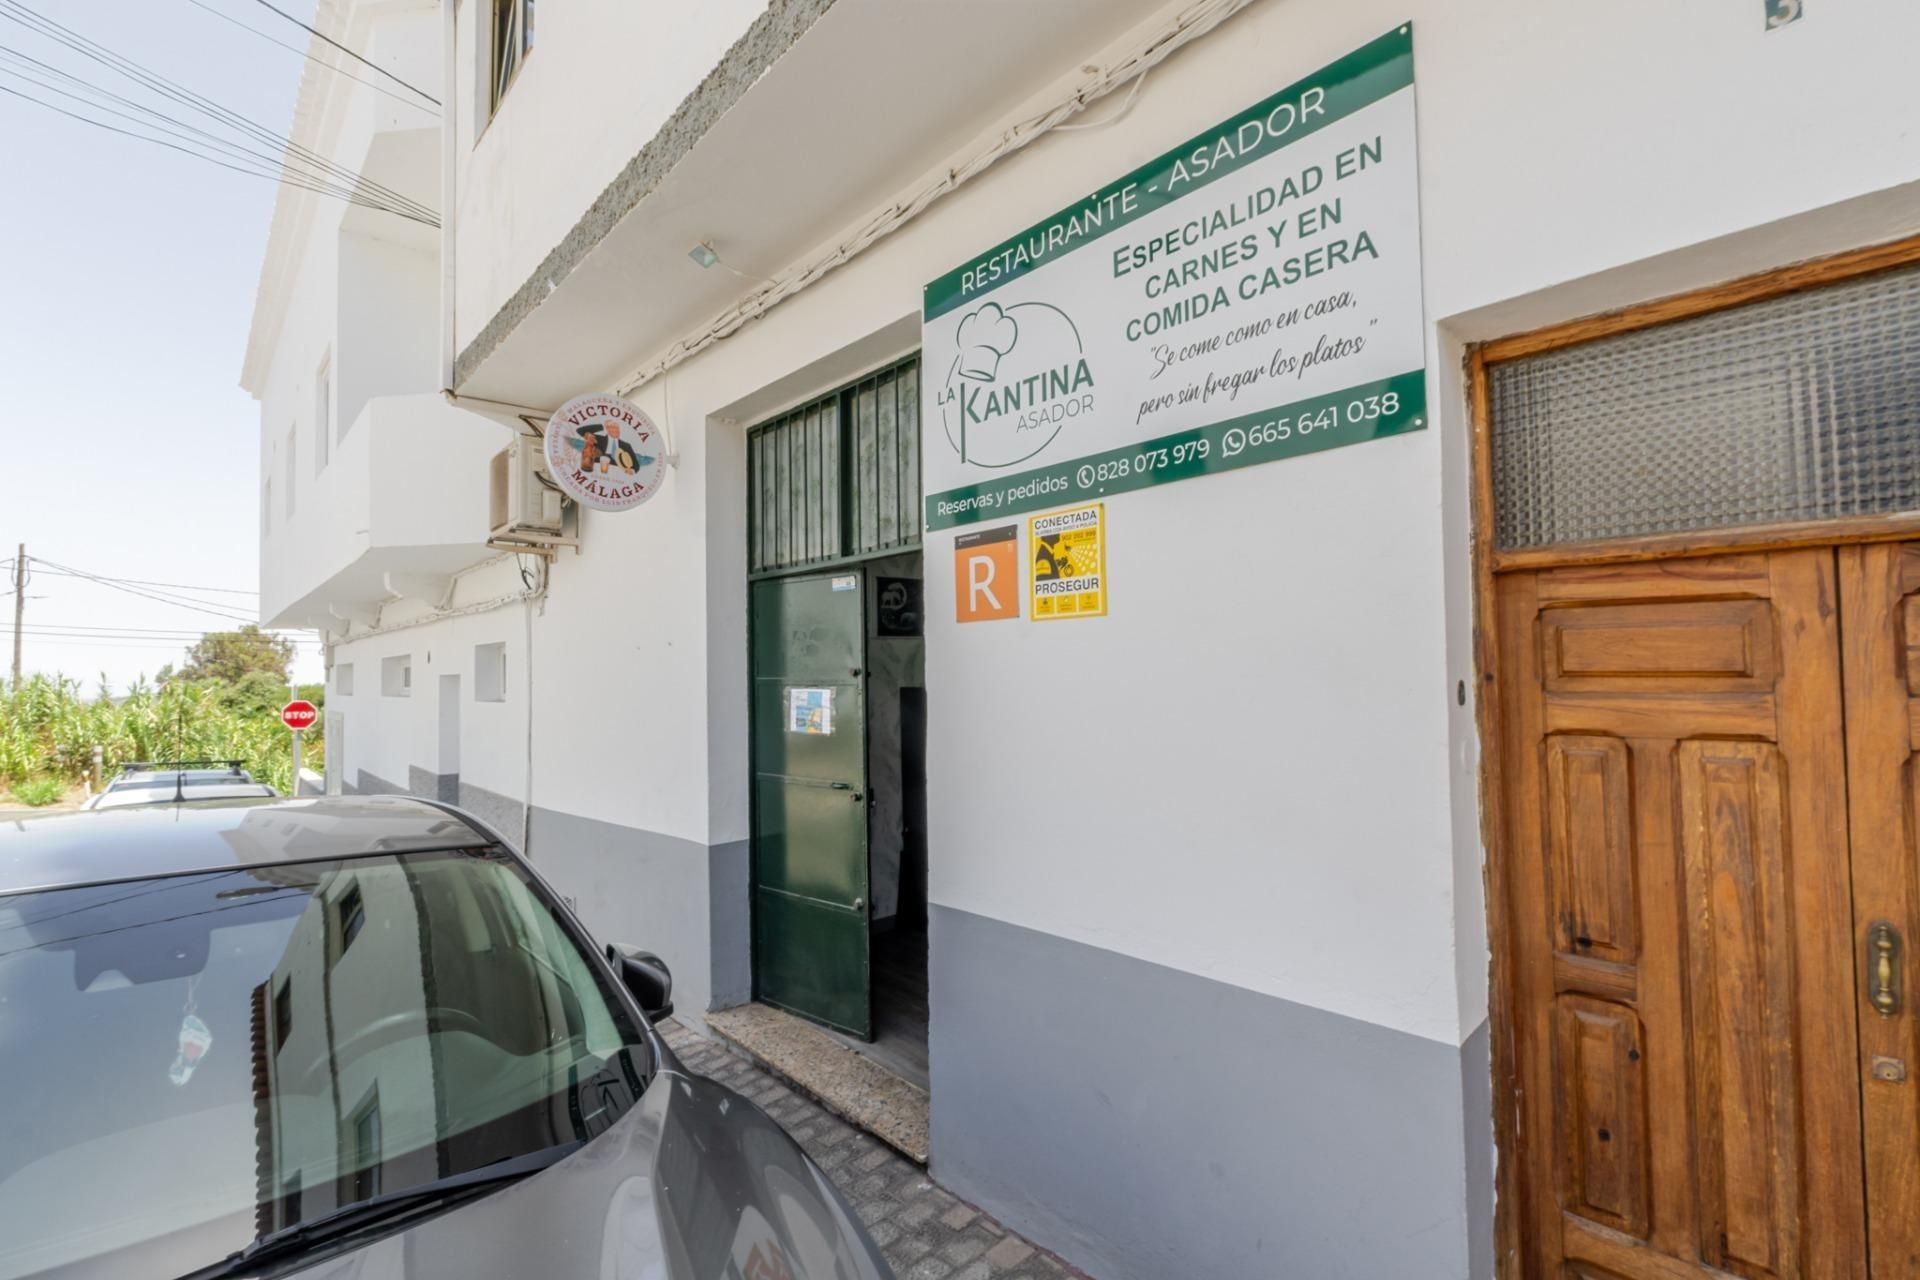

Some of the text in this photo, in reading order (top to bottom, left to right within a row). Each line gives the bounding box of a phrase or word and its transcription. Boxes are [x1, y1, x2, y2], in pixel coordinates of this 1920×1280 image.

[961, 183, 1138, 295] RESTAURANTE
[1168, 87, 1325, 190] ASADOR
[1113, 136, 1383, 278] ESPECIALIDAD EN
[1145, 198, 1342, 299] CARNES Y EN
[1126, 230, 1379, 342] COMIDA CASERA
[1180, 336, 1220, 362] come
[1226, 319, 1273, 346] como
[1276, 307, 1302, 329] en
[1304, 290, 1357, 320] casa,
[937, 387, 956, 406] LA
[959, 358, 1095, 464] KANTINA
[1016, 394, 1095, 433] ASADOR
[1136, 392, 1173, 425] pero
[1178, 379, 1201, 405] sin
[1202, 372, 1267, 404] fregar
[1269, 348, 1298, 379] los
[568, 405, 651, 443] VICTORIA
[937, 392, 1400, 517] Reservas y pedidos 828 073 979 665 641 038
[571, 469, 645, 499] MÁLAGA
[1034, 510, 1097, 530] CONECTADA
[968, 555, 1002, 612] R
[1035, 577, 1099, 595] PROSEGUR
[284, 711, 315, 719] STOP
